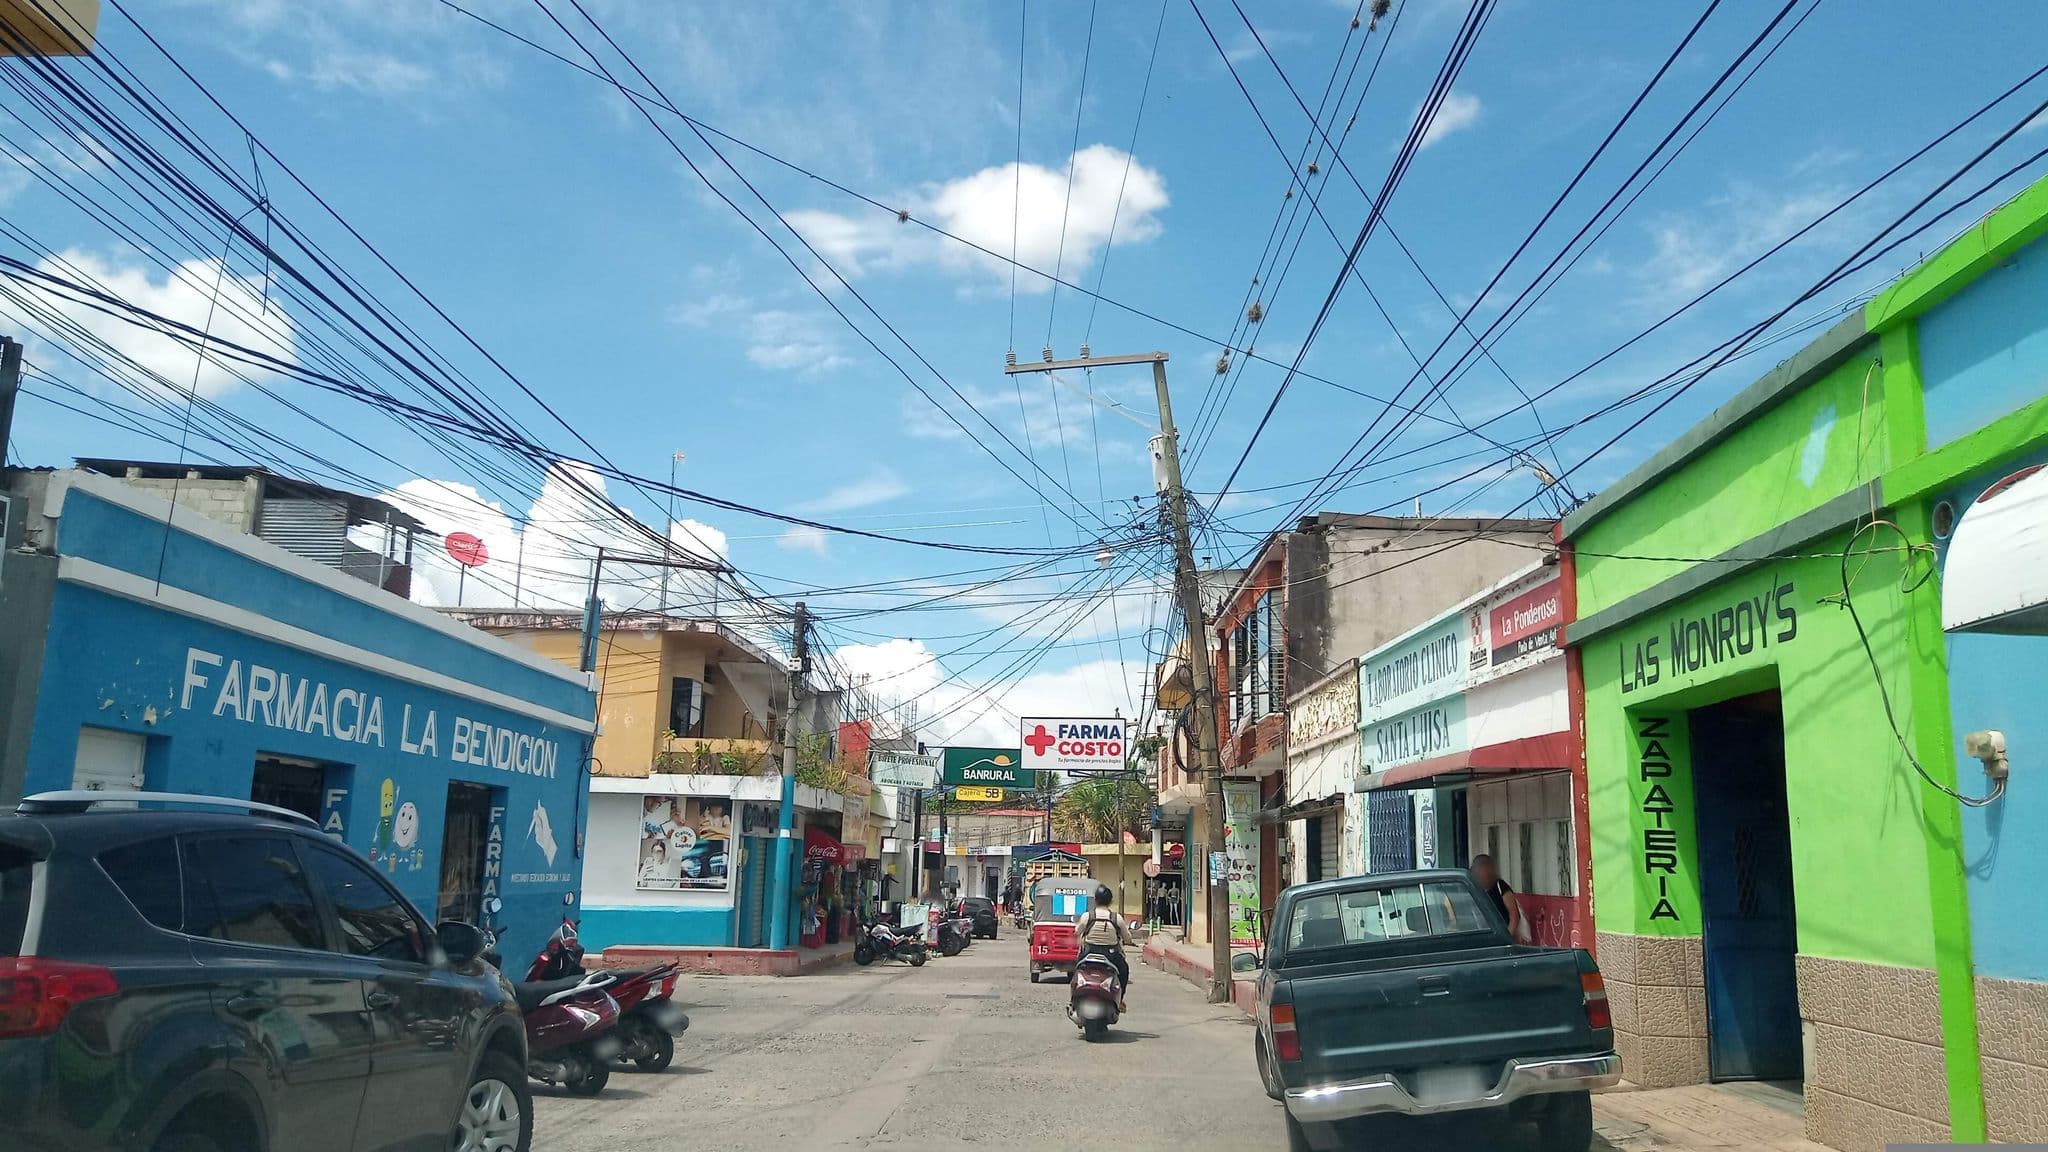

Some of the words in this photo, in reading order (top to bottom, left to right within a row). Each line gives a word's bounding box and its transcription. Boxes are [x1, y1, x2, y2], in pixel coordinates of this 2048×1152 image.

[1501, 616, 1512, 637] La
[1514, 598, 1557, 633] Ponderosa
[1620, 637, 1660, 694] LAS
[1671, 573, 1797, 678] MONROY'S
[1368, 651, 1419, 707] LABORATORIO
[1421, 632, 1458, 684] CLINICO
[181, 647, 385, 748] FARMACIA
[401, 703, 438, 758] LA
[452, 716, 559, 779] BENDICIÓN
[1058, 724, 1121, 739] FARMA
[1058, 741, 1121, 756] COSTO
[1377, 721, 1410, 764] SANTA
[1412, 707, 1450, 756] LUISA
[958, 789, 980, 797] Cajero
[985, 788, 999, 798] 5B
[963, 769, 1016, 781] BANRURAL
[1638, 717, 1680, 921] ZAPATERIA
[1037, 945, 1048, 954] 15
